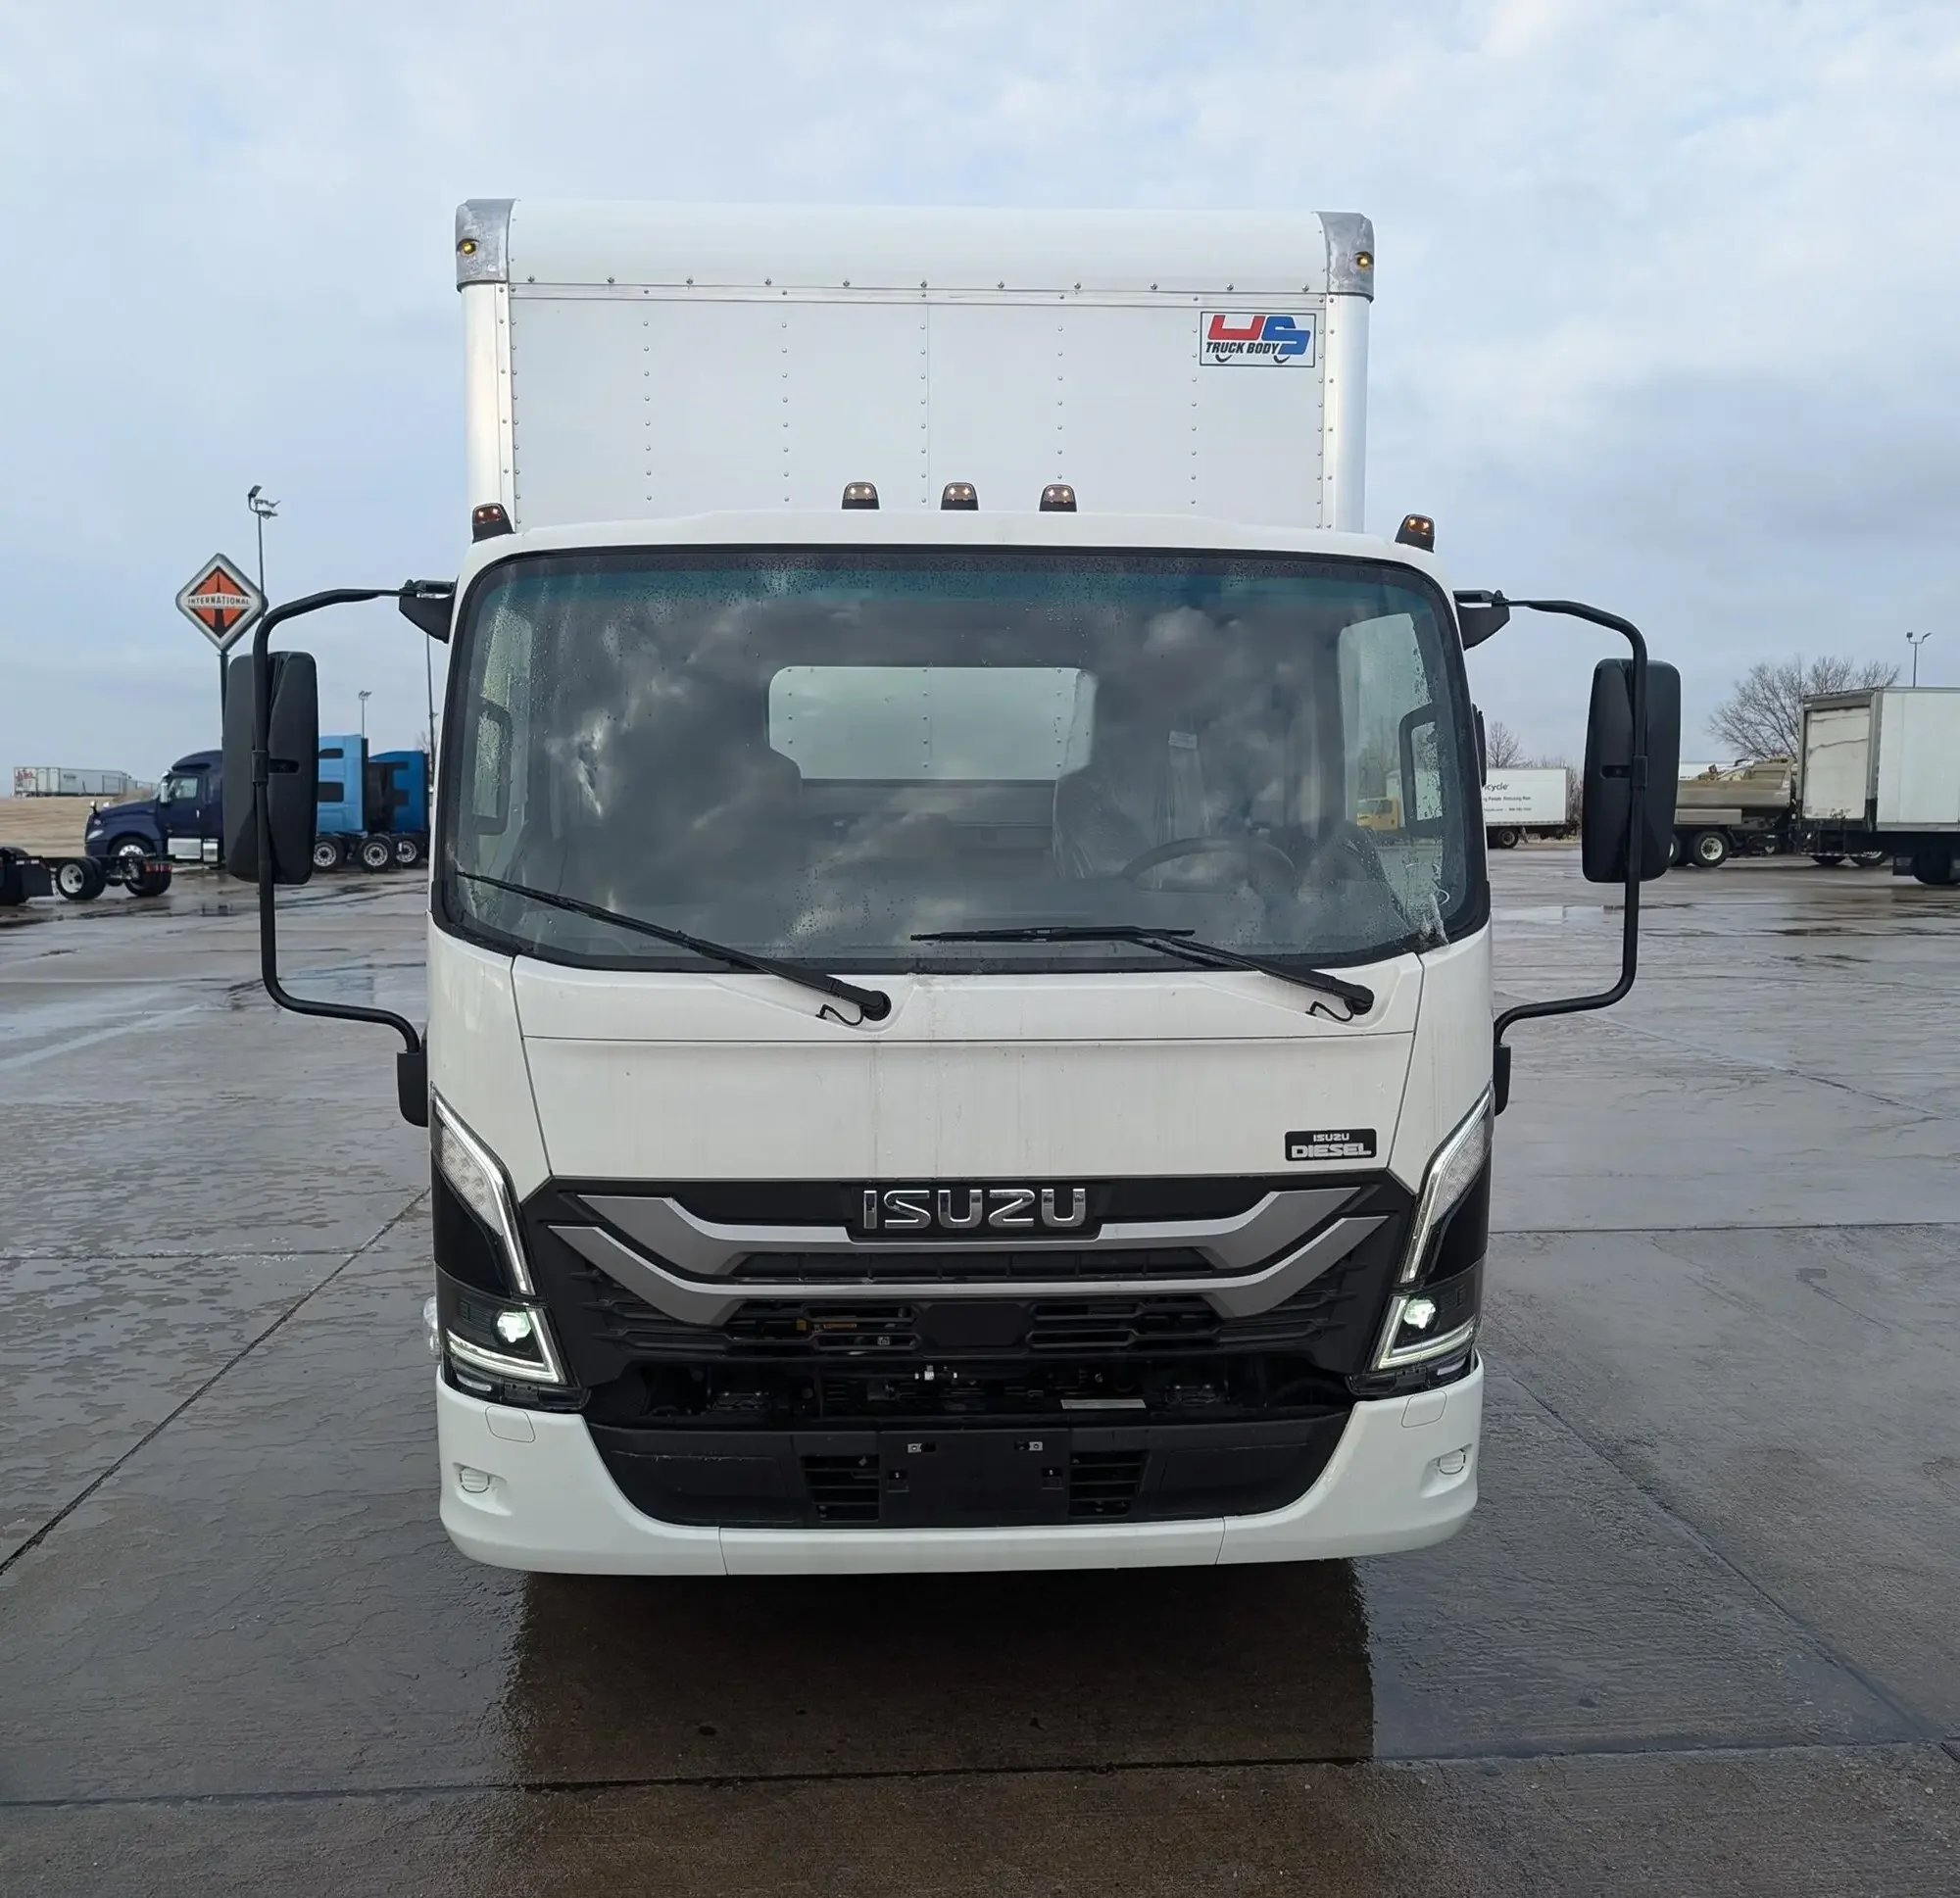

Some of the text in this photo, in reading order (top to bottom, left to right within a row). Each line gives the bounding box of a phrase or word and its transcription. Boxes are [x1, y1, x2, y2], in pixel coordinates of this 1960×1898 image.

[1207, 315, 1311, 355] US
[1205, 341, 1279, 354] TRUCK BODY
[187, 596, 249, 605] INTERNATIONAL
[1313, 1133, 1349, 1143] ISUZU
[1291, 1143, 1372, 1158] DIESEL
[863, 1189, 1086, 1229] ISUZU
